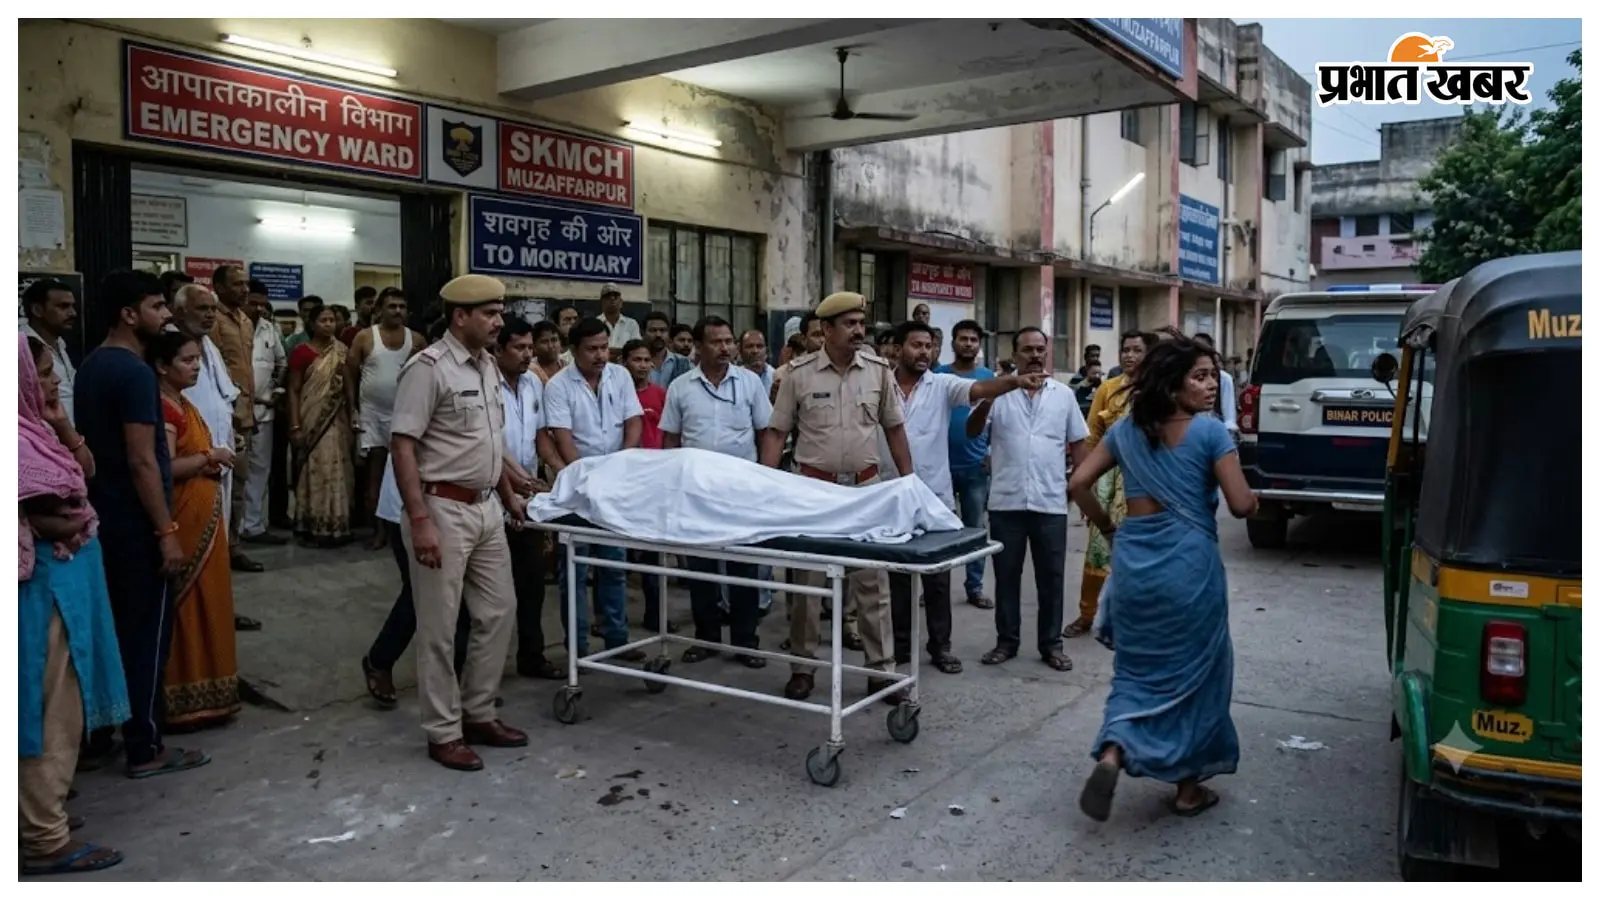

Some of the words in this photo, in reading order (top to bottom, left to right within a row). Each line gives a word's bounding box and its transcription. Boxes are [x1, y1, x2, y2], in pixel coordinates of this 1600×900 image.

[141, 65, 328, 122] आपातकालीन
[339, 95, 413, 137] विभाग
[141, 101, 331, 156] EMERGENCY
[338, 135, 414, 170] WARD
[510, 131, 624, 179] SKMCH
[507, 167, 627, 202] MUZAFFARPUR
[481, 211, 551, 245] शवगृह
[560, 215, 588, 242] की
[597, 219, 632, 247] ओर
[483, 244, 514, 265] TO
[520, 247, 632, 274] MORTUARY
[1528, 308, 1582, 339] Muz
[1361, 410, 1396, 422] POLIC
[1478, 712, 1527, 736] Muz.
